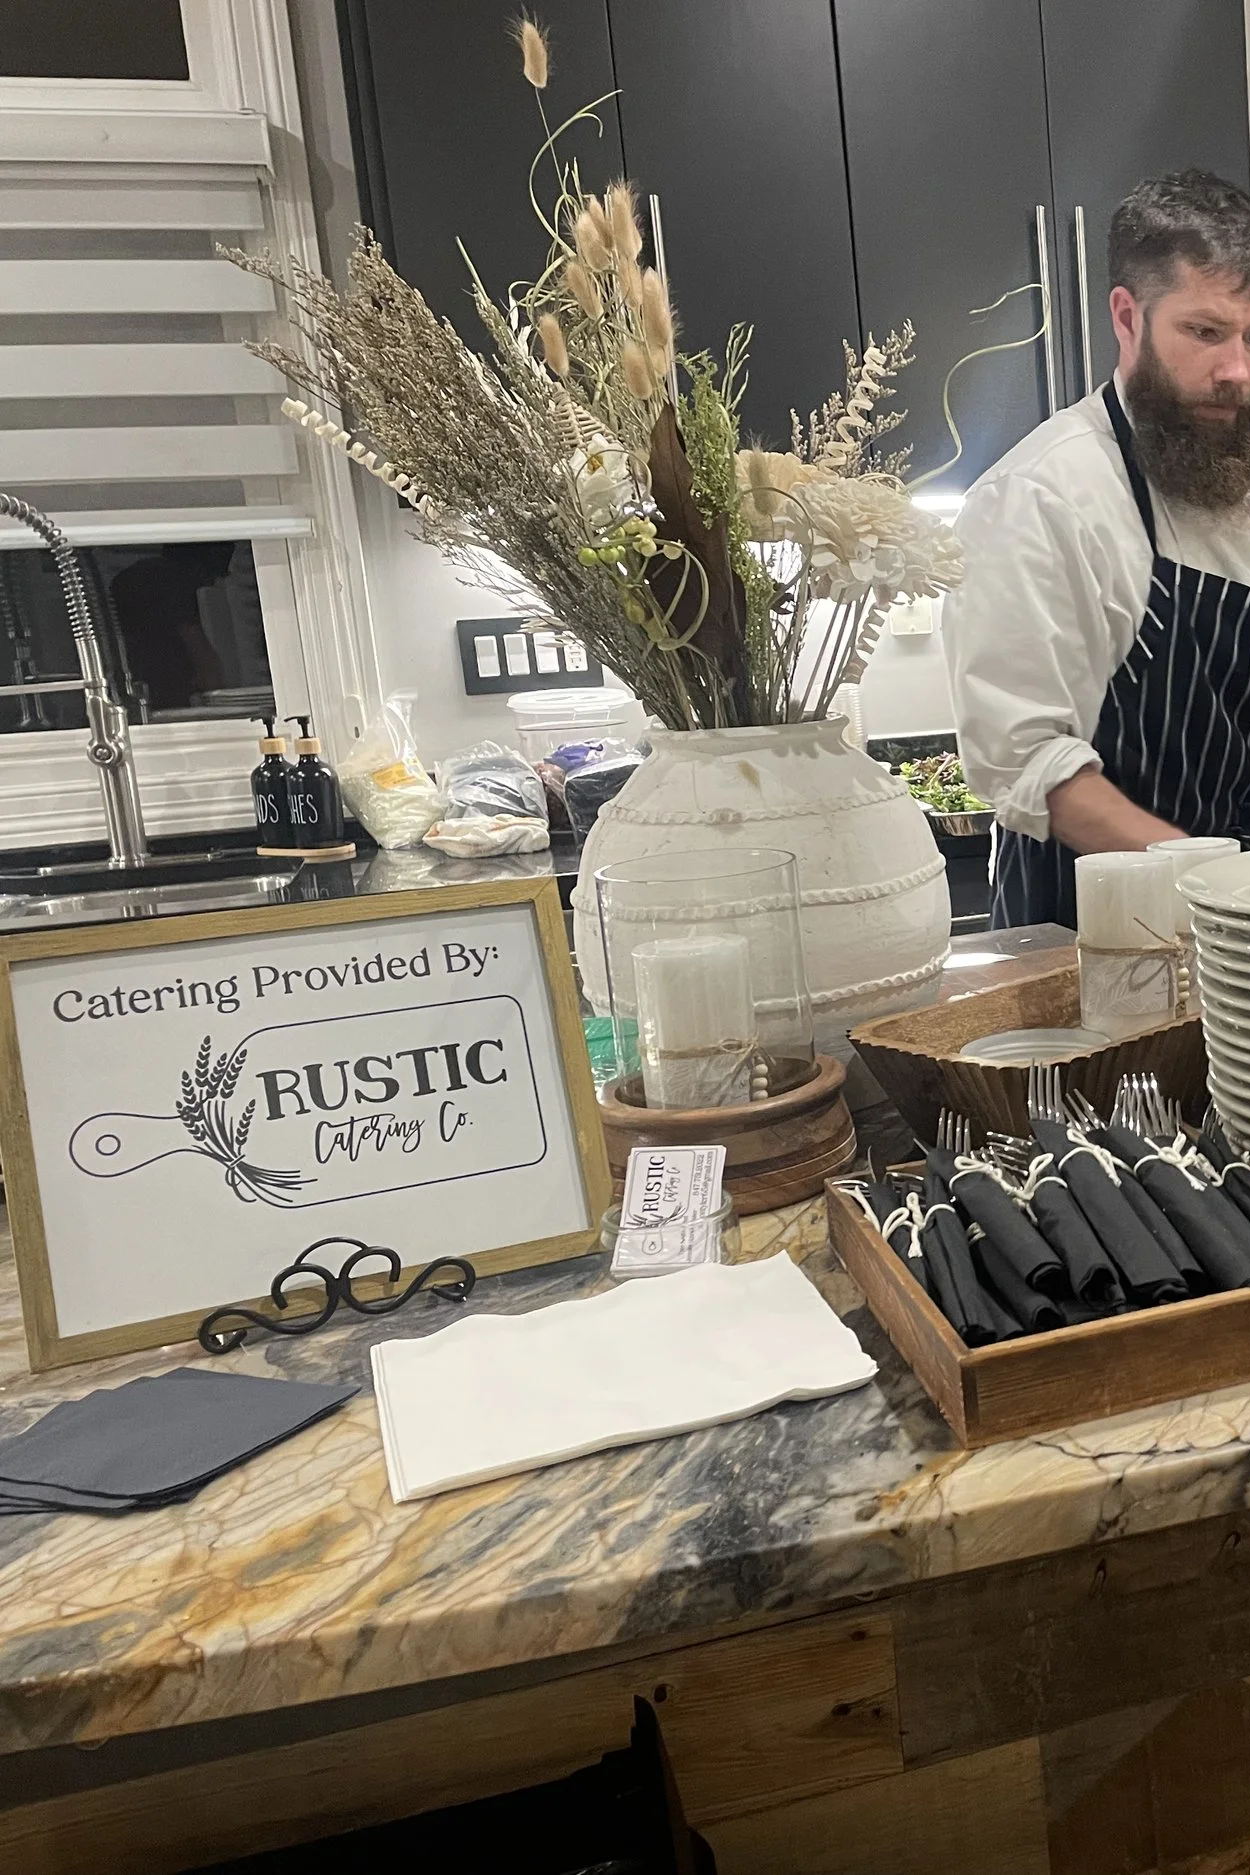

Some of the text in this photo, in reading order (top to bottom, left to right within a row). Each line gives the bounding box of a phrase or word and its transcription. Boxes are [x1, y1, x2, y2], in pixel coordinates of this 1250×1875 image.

[52, 942, 499, 1022] Catering Provided By:
[255, 1038, 508, 1121] RUSTIC
[314, 1100, 474, 1165] Catering Co.
[642, 1155, 666, 1213] RUSTIC
